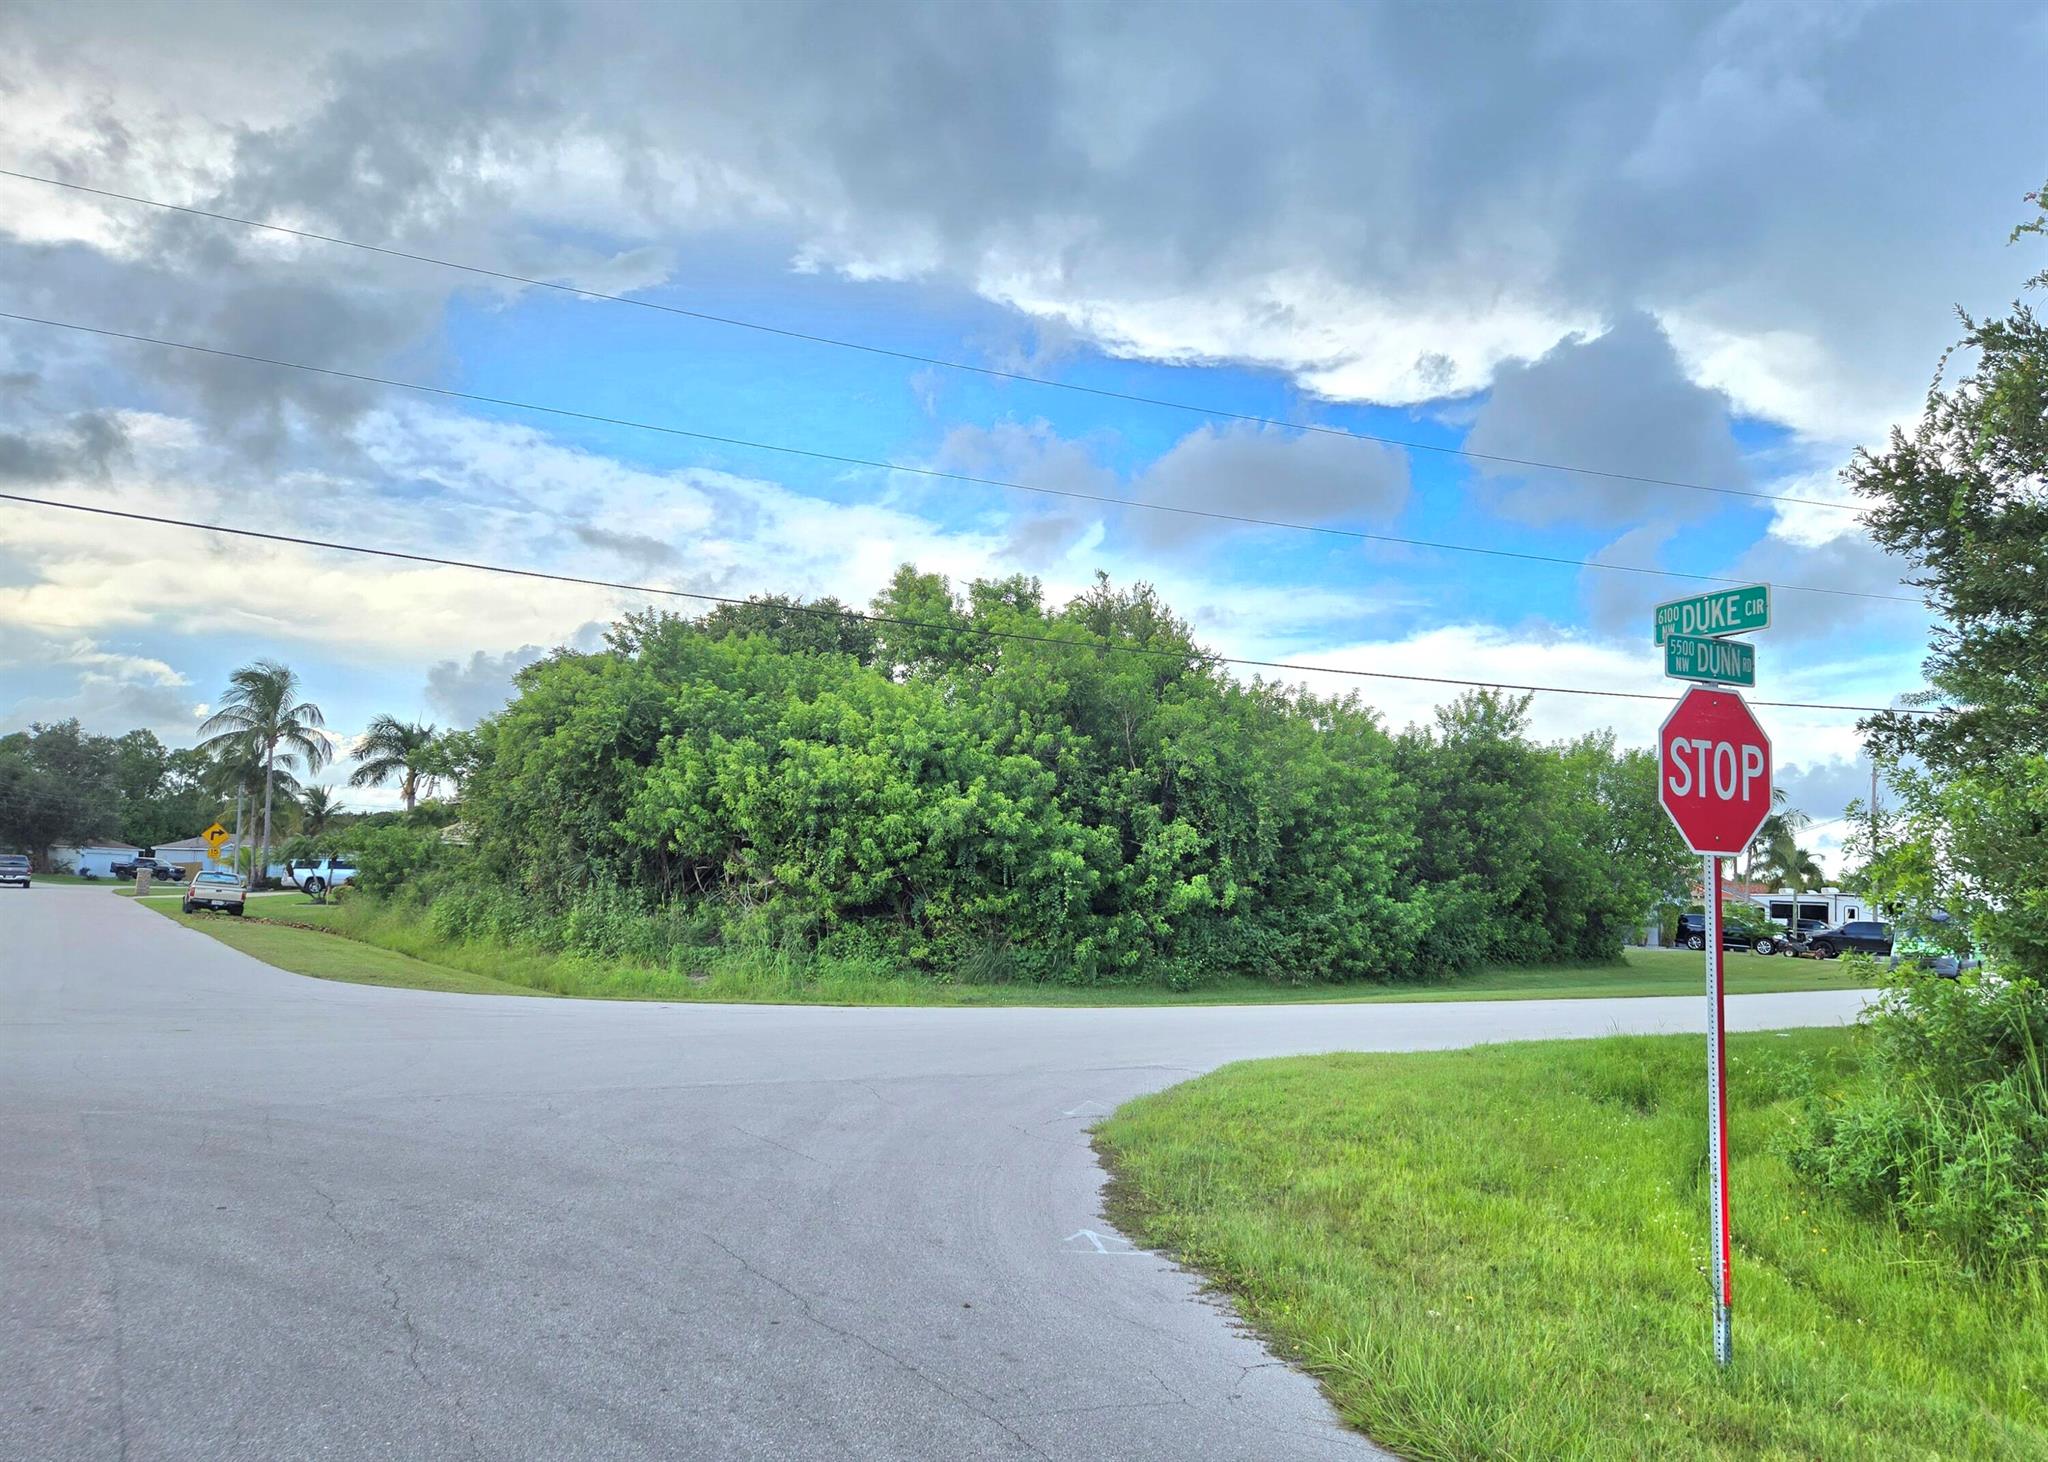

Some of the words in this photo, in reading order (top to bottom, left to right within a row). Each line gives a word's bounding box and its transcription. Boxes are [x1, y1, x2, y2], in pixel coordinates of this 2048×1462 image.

[1658, 606, 1680, 624] 6100
[1683, 595, 1741, 634] DUKE
[1745, 598, 1764, 616] CIR
[1670, 639, 1695, 656] 5500
[1697, 643, 1741, 677] DUNN
[1743, 656, 1752, 673] RD
[1675, 656, 1690, 672] NW
[1669, 736, 1764, 801] STOP
